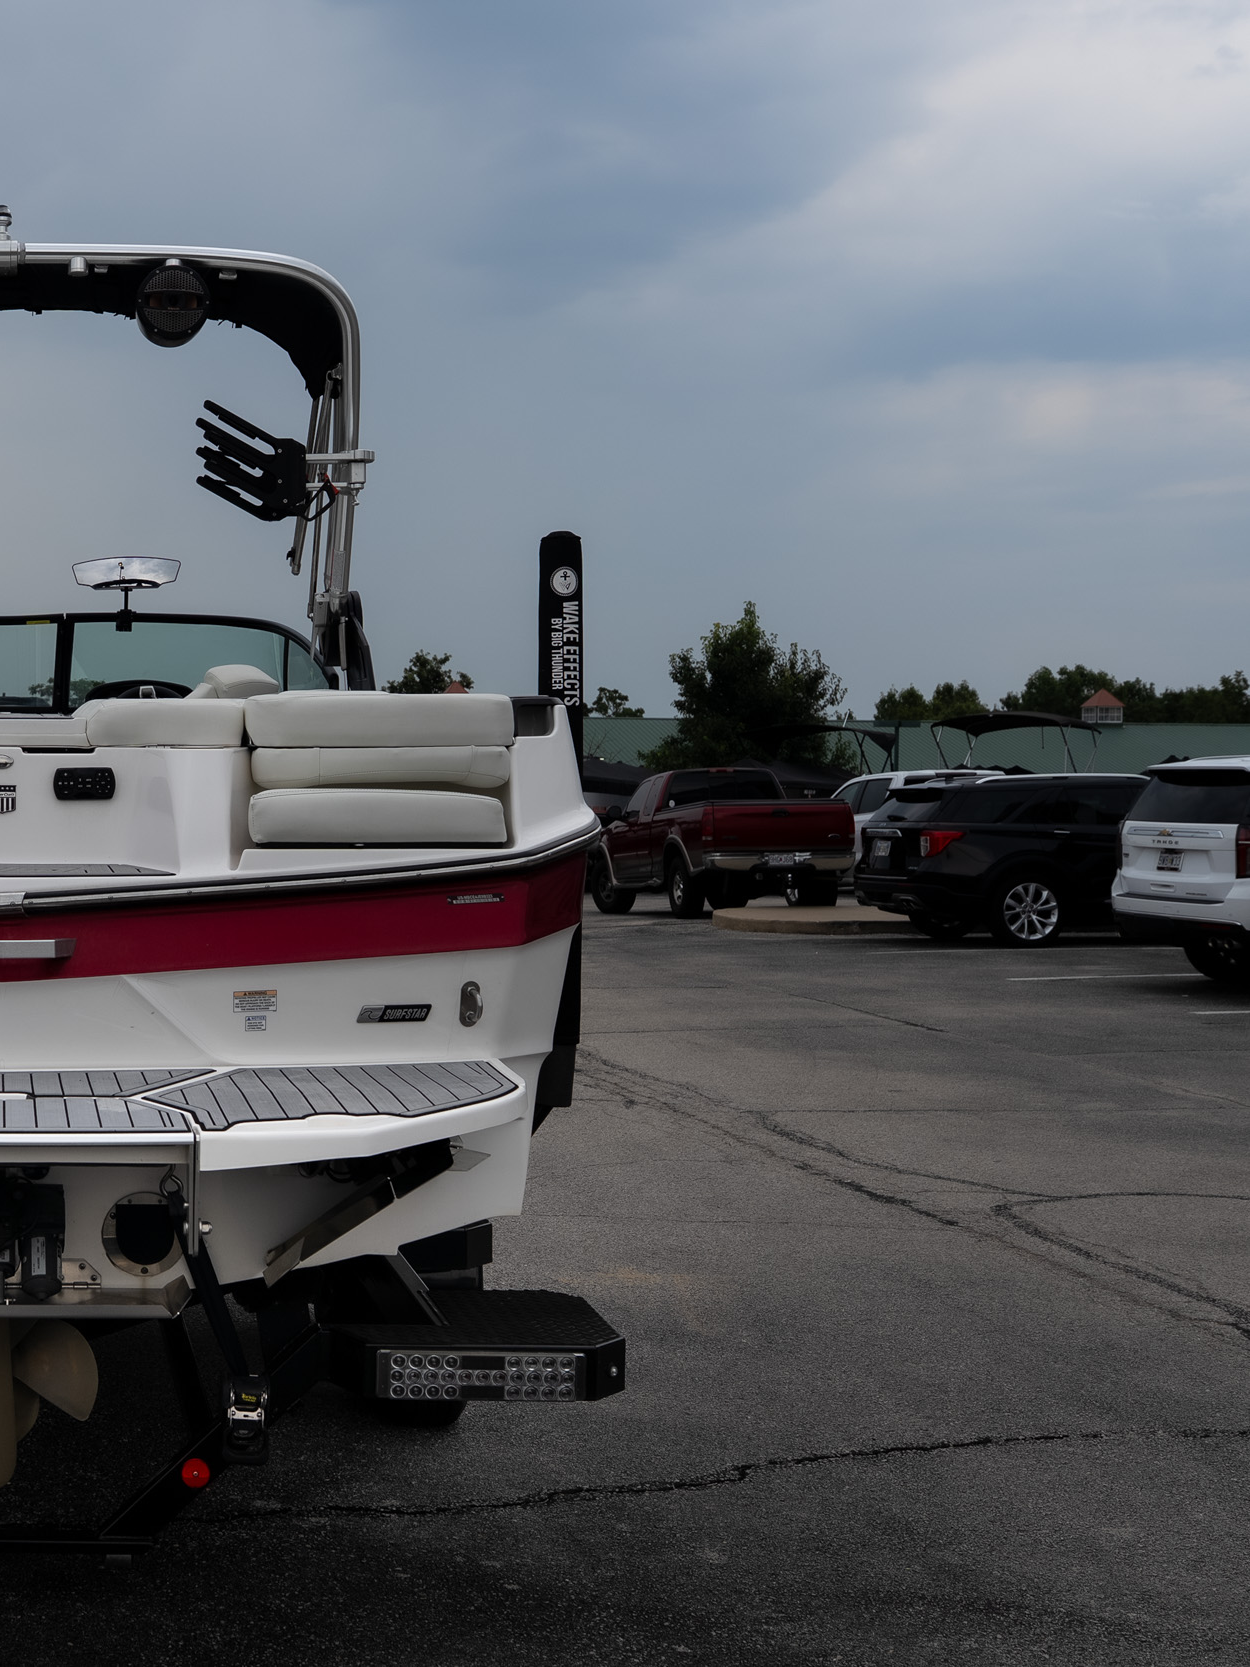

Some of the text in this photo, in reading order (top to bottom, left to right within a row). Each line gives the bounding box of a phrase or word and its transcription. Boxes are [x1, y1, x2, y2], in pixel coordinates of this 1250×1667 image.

[551, 618, 564, 690] BY BIG THUNDER
[563, 601, 580, 707] WAKE EFFECTS
[383, 1008, 428, 1020] SURFSTAR
